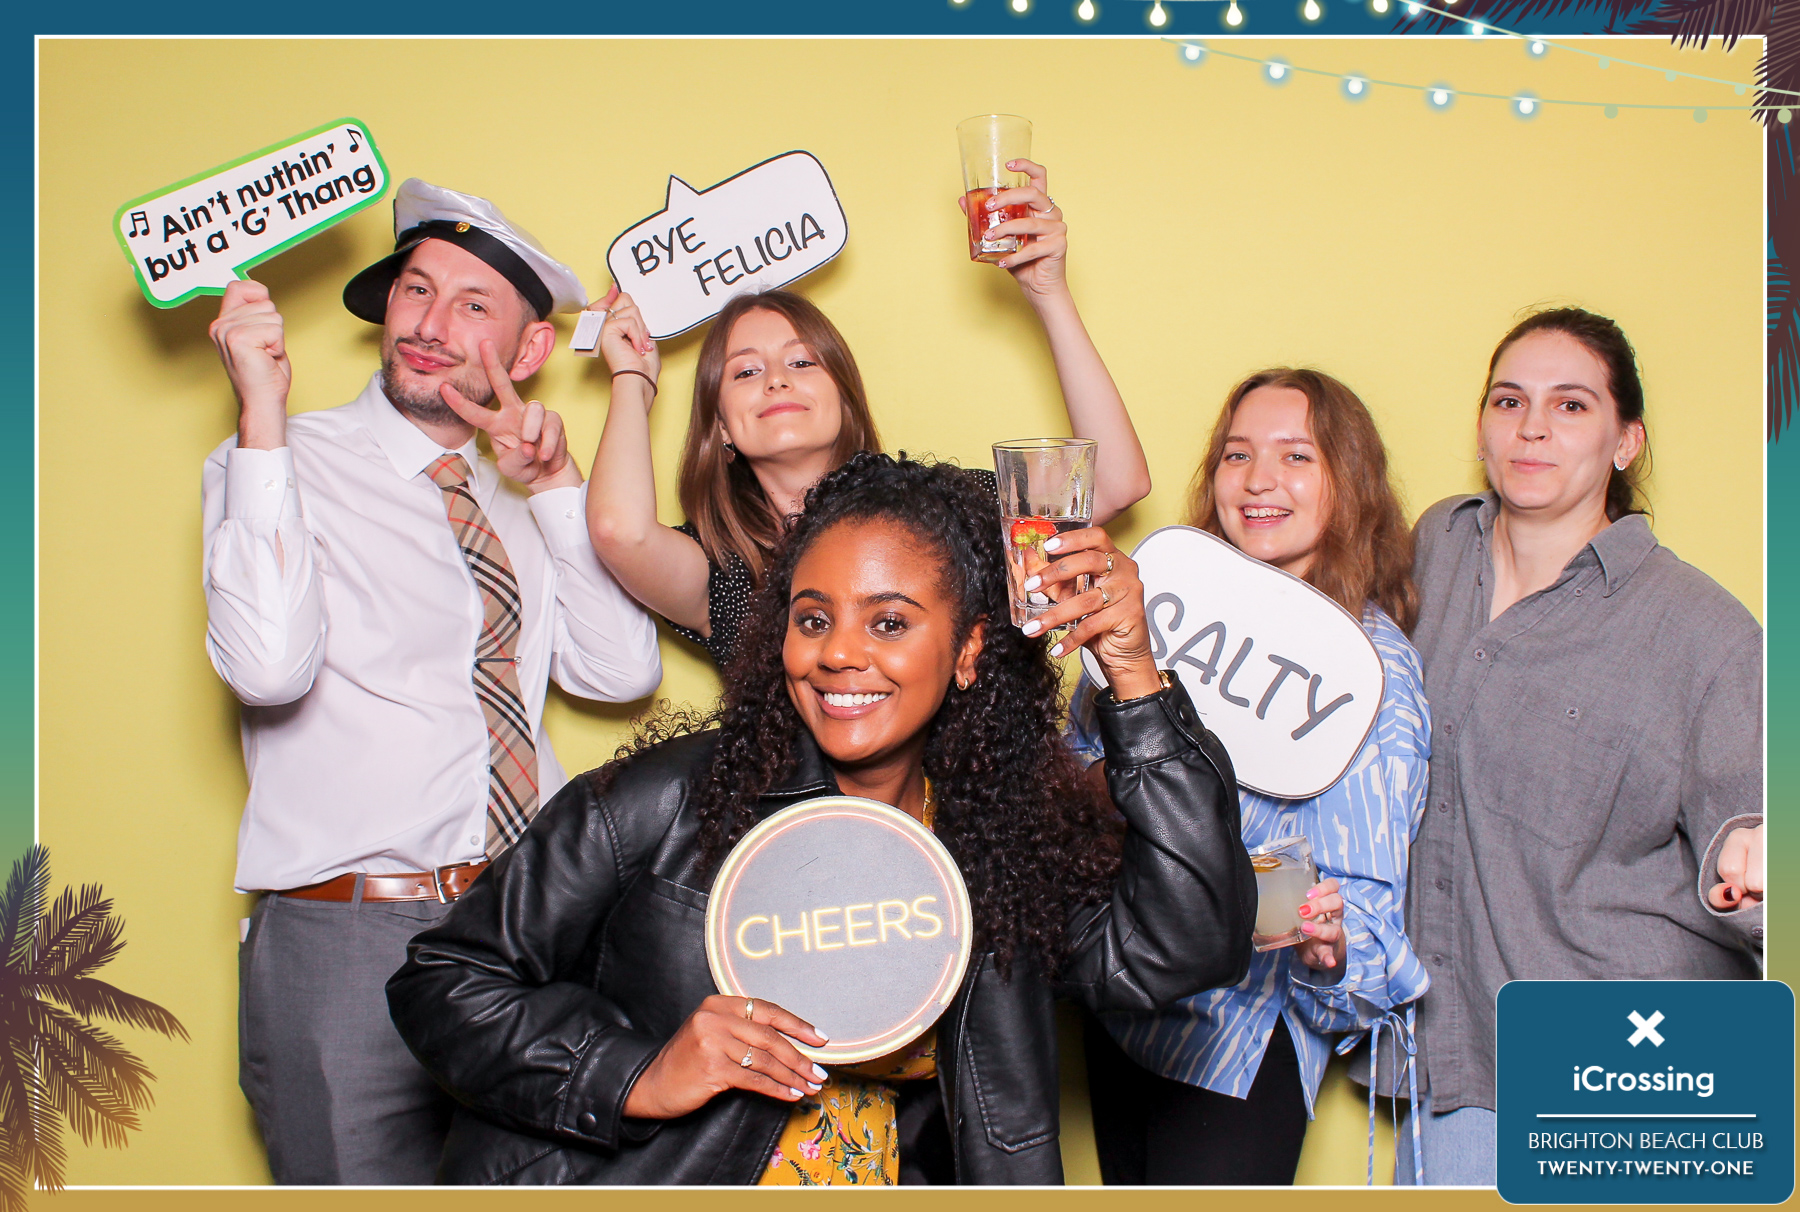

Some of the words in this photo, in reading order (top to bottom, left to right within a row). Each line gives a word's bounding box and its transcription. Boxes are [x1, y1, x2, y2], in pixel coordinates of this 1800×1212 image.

[144, 239, 200, 282] but
[206, 230, 230, 254] a
[231, 206, 270, 236] 'G'
[277, 164, 377, 220] Thang
[162, 190, 231, 243] Ain't
[236, 143, 335, 207] nuthin'
[631, 217, 706, 276] BYE
[693, 213, 826, 296] FELICIA
[1145, 592, 1354, 741] SALTY
[735, 894, 944, 959] CHEERS
